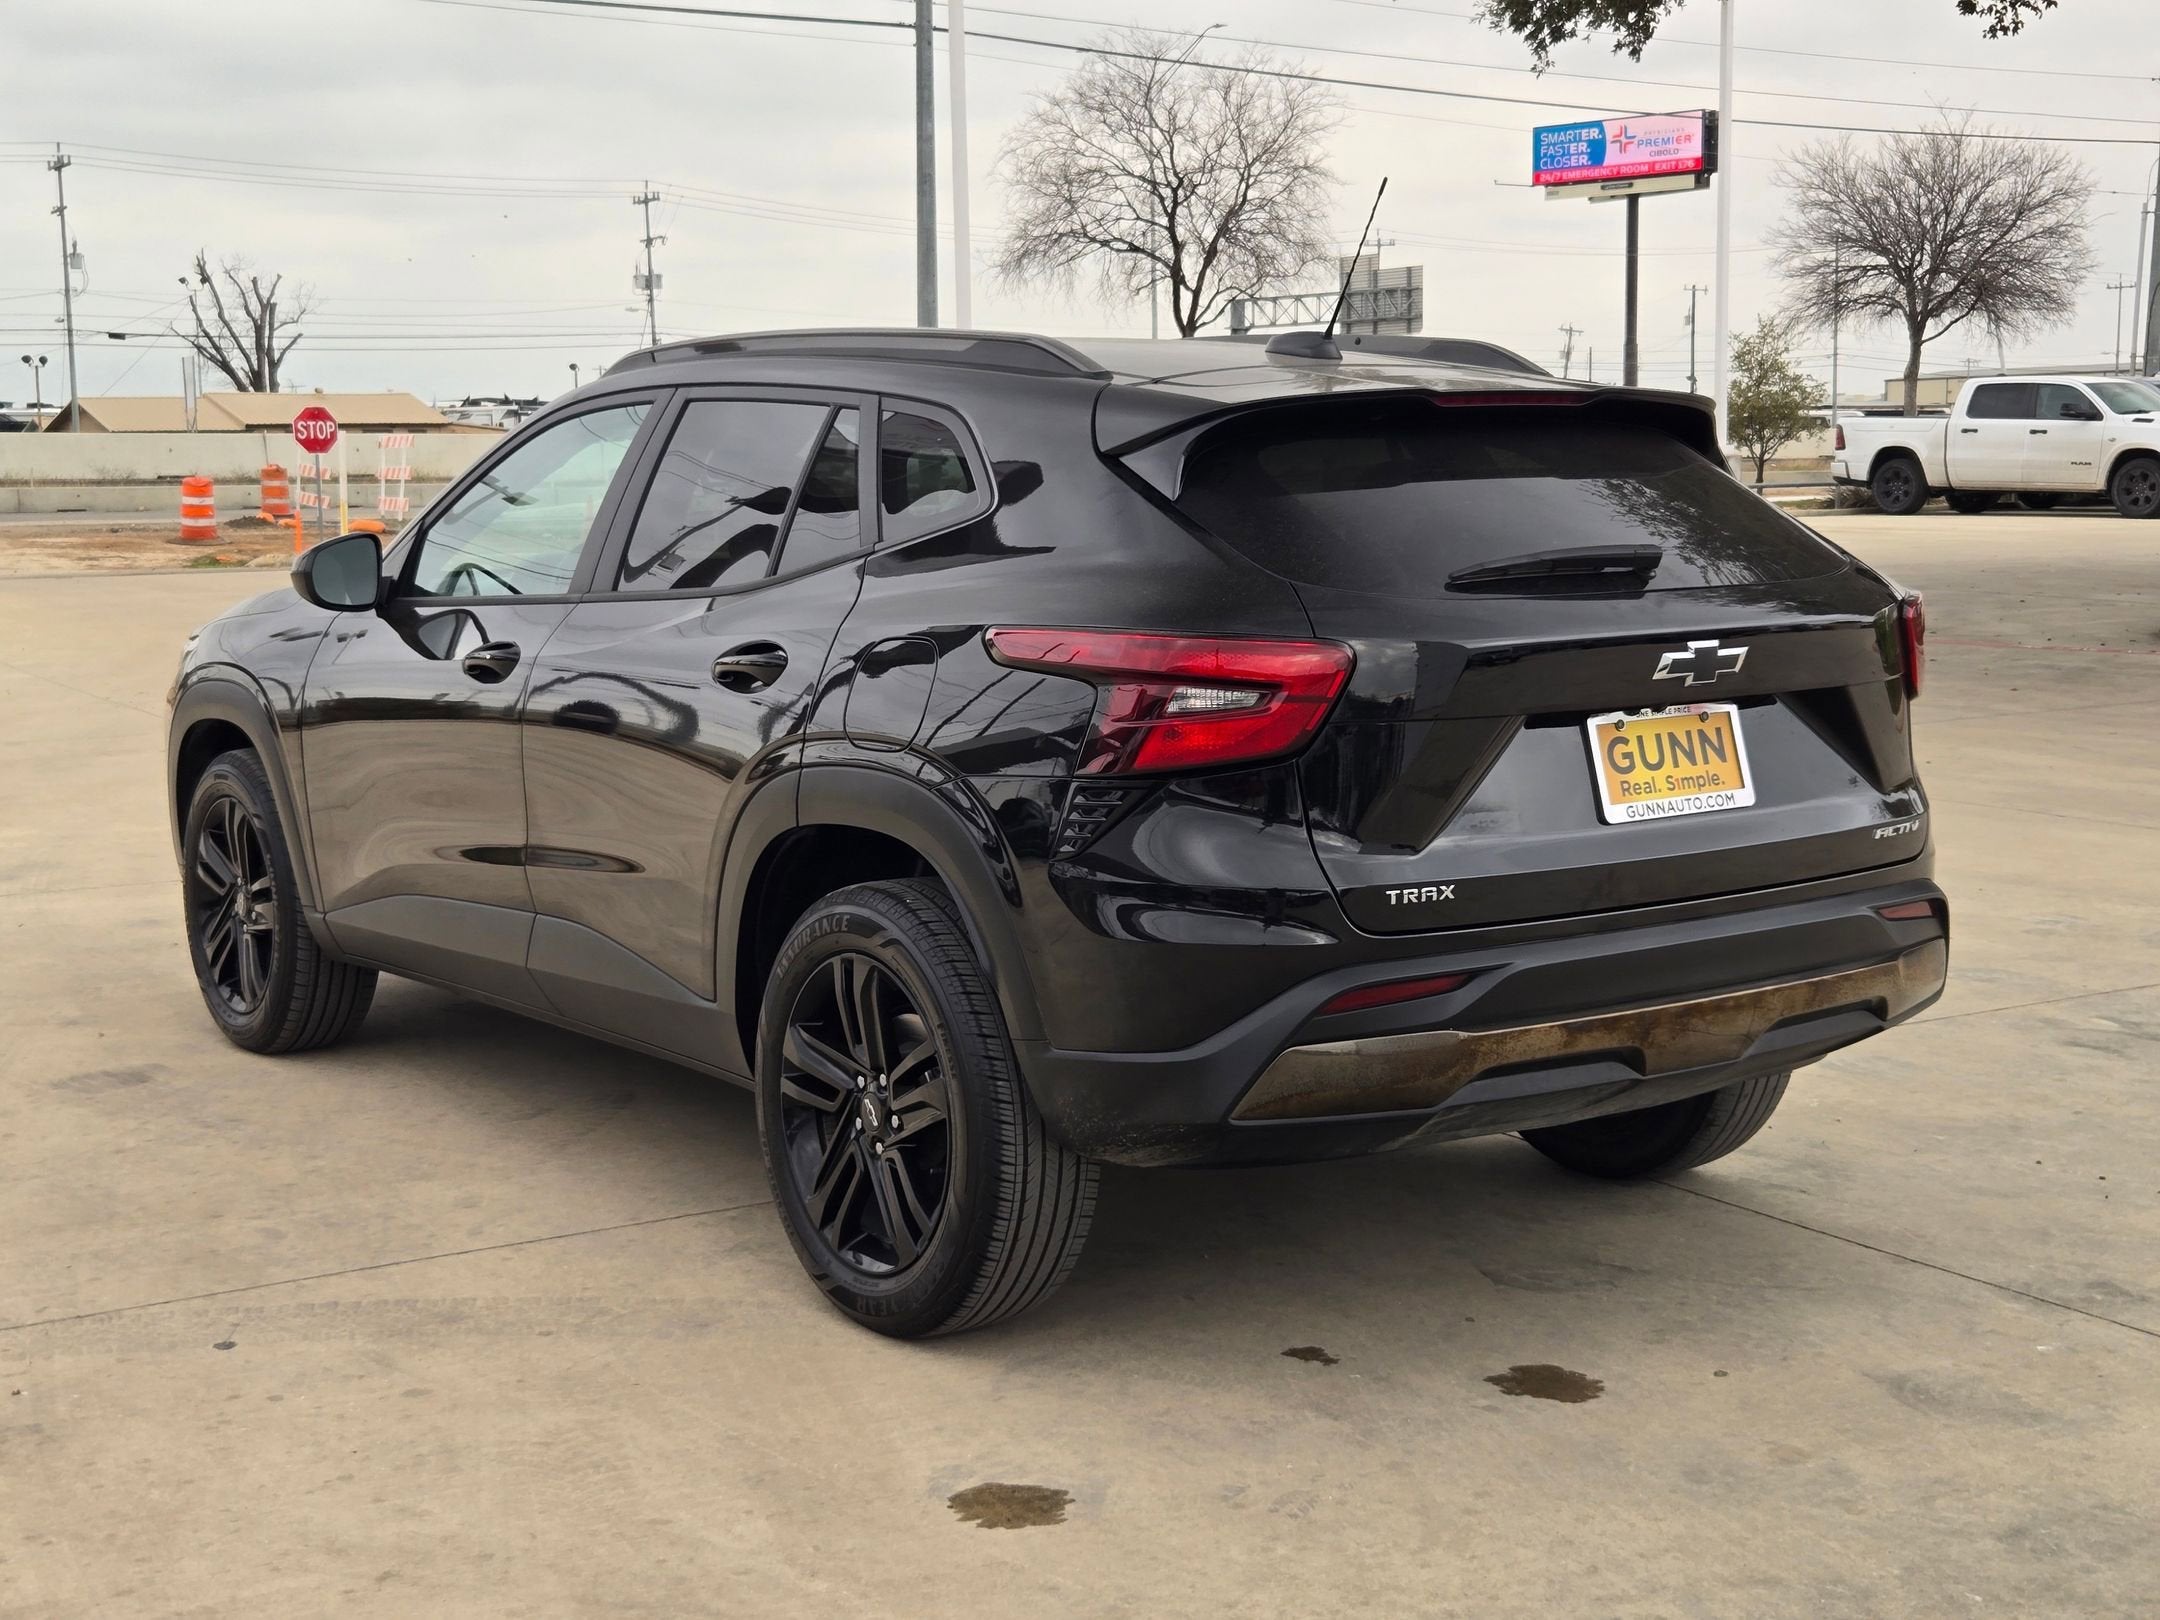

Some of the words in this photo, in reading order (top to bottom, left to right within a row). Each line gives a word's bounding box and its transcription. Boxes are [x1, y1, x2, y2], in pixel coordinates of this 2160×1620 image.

[1540, 128, 1602, 145] SMARTER.
[1637, 134, 1692, 148] PREMIER
[1540, 142, 1591, 157] FASTER.
[1649, 148, 1680, 157] CIBOLO
[1540, 155, 1592, 170] CLOSER.
[1540, 172, 1561, 183] 24/7
[1561, 166, 1617, 180] EMERGENCY
[1620, 163, 1649, 174] ROOM
[1654, 161, 1677, 171] EXIT
[297, 420, 335, 440] STOP
[1674, 705, 1692, 714] PRICE
[1607, 726, 1727, 775] GUNN
[1620, 776, 1662, 797] Real.
[1626, 792, 1736, 819] GUNNAUTO.COM
[1385, 884, 1456, 905] TRAX
